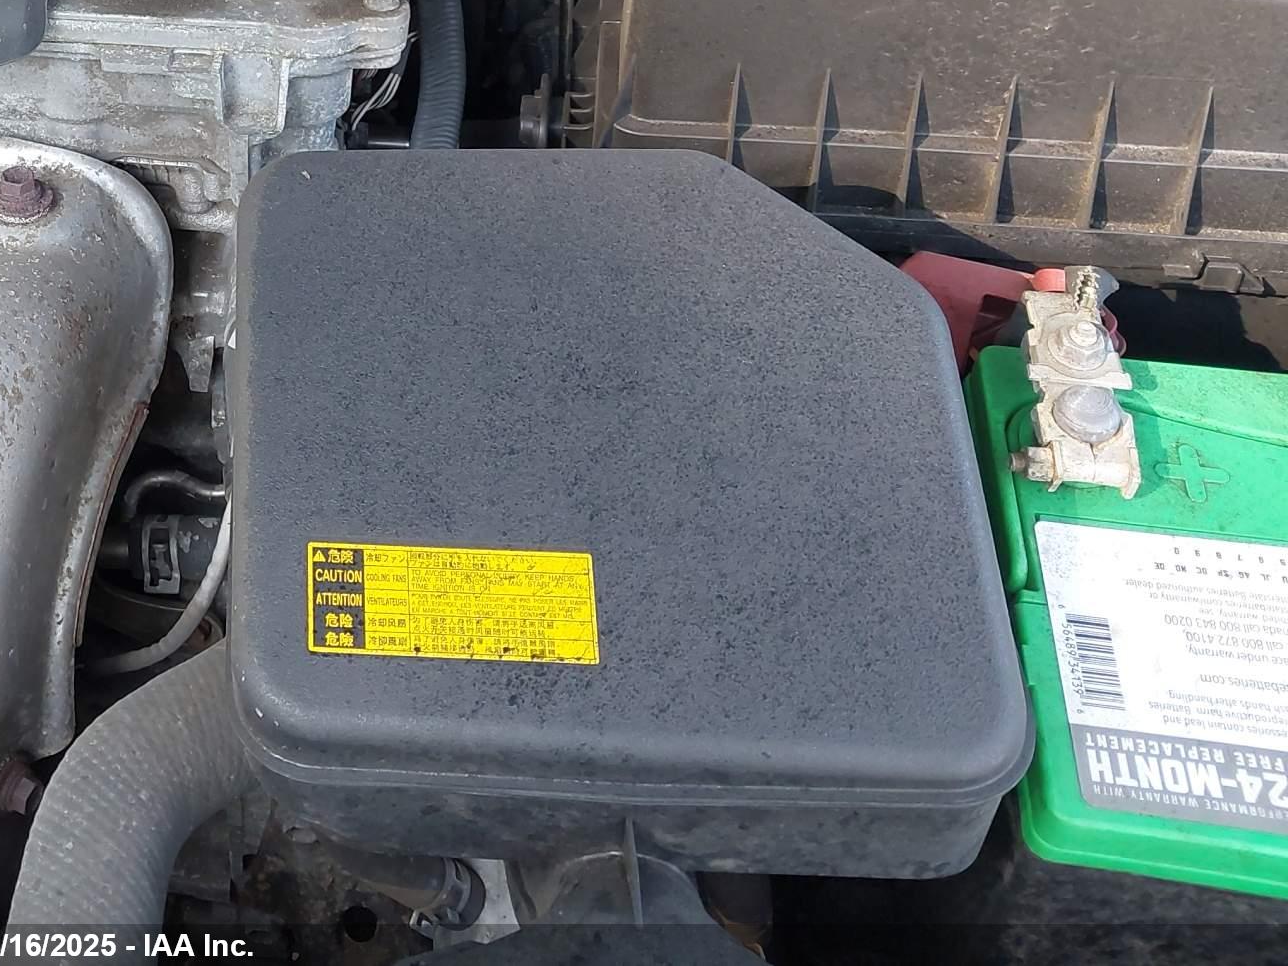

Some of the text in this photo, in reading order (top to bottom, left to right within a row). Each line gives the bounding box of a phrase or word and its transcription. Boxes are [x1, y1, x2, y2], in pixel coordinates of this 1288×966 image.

[315, 568, 362, 584] CAUTION
[316, 592, 362, 607] ATTENTION
[1085, 732, 1284, 772] FREE REPLACEMENT
[1093, 785, 1124, 798] WITH
[1131, 789, 1199, 808] WARRANTY
